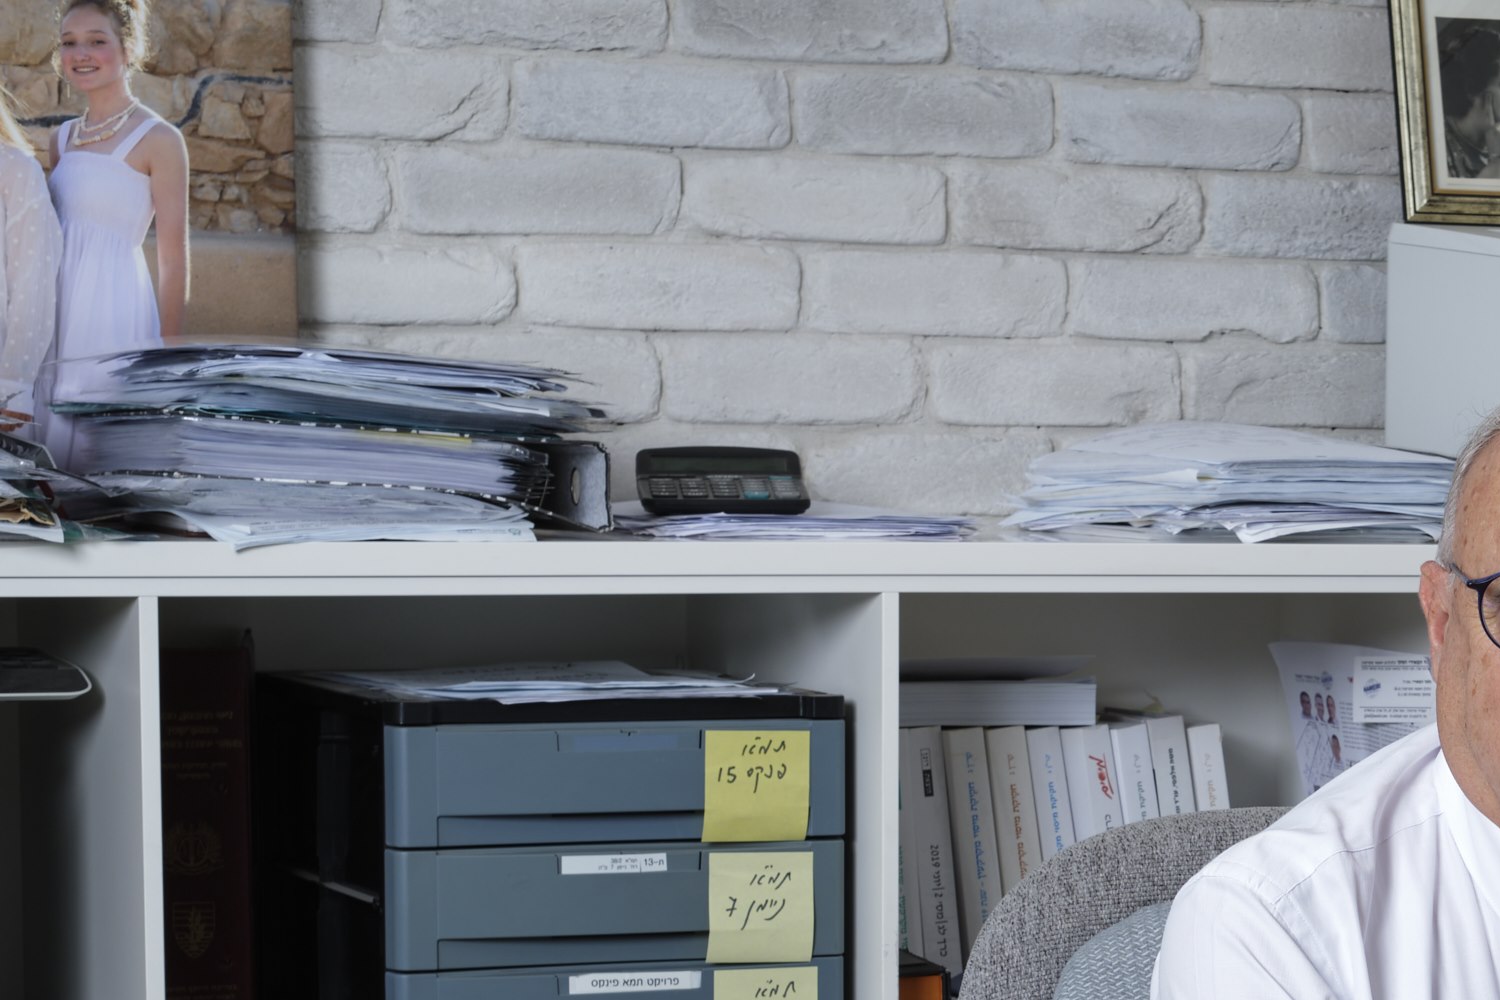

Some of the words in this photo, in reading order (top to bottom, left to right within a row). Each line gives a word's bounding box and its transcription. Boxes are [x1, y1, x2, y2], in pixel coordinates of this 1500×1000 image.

[718, 766, 737, 783] 15
[930, 845, 941, 868] 2019
[725, 896, 737, 918] 7
[937, 939, 948, 957] כרך
[591, 979, 619, 988] פינקס
[622, 977, 644, 987] תמא
[647, 977, 680, 988] פרויקט
